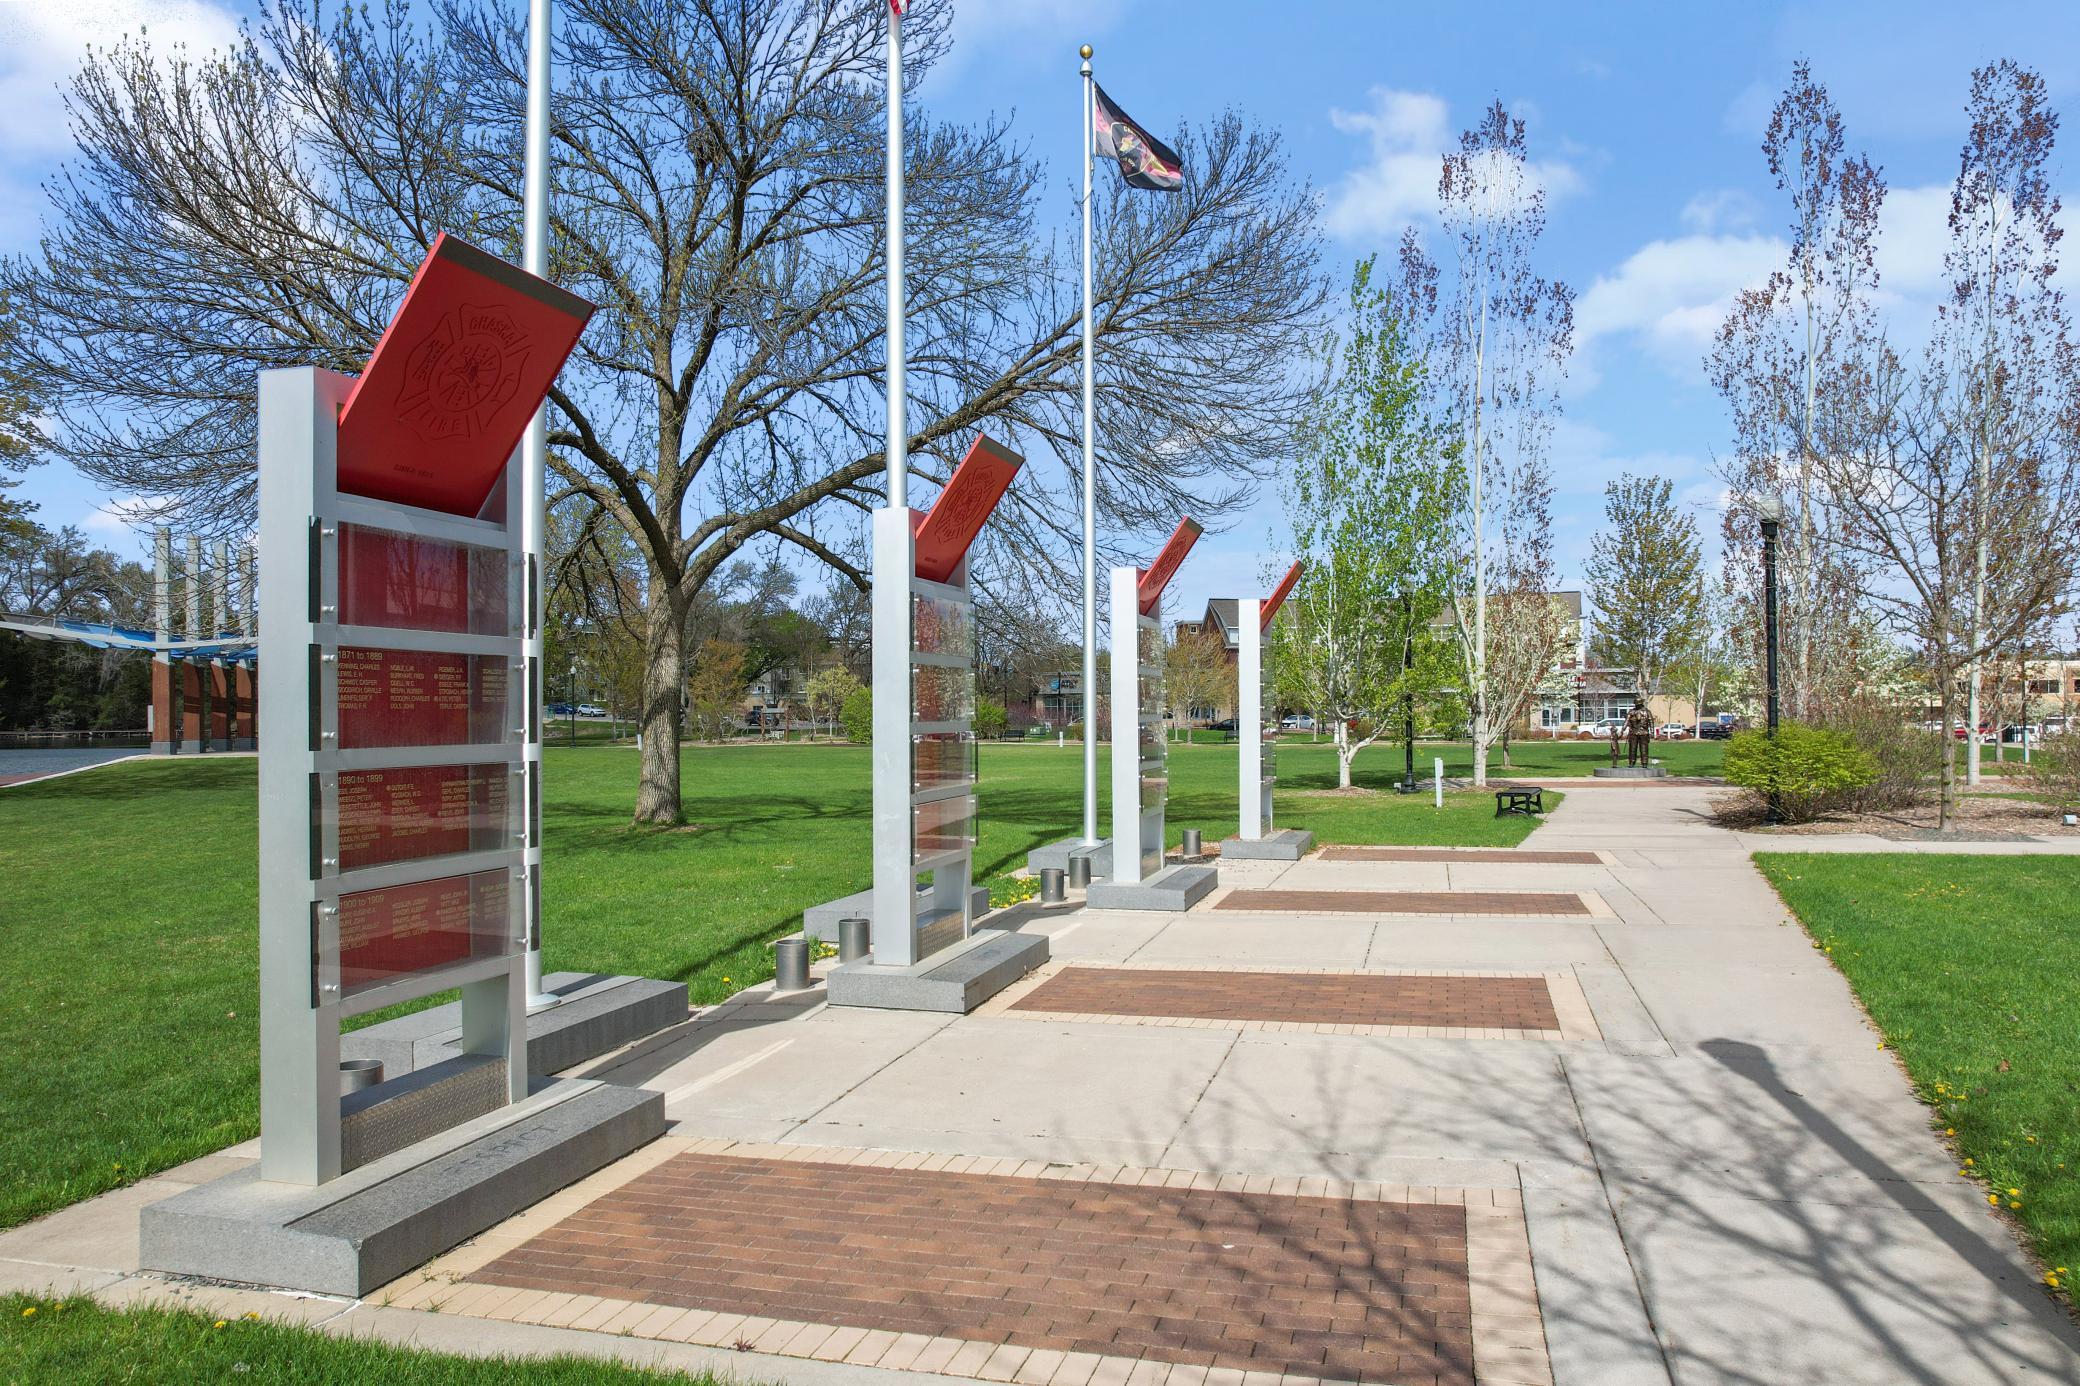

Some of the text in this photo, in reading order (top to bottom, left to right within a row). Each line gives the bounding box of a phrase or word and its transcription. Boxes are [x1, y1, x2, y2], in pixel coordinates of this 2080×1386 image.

[339, 651, 382, 660] 1871 to 1889
[339, 776, 356, 784] 1890
[367, 774, 383, 783] 1899
